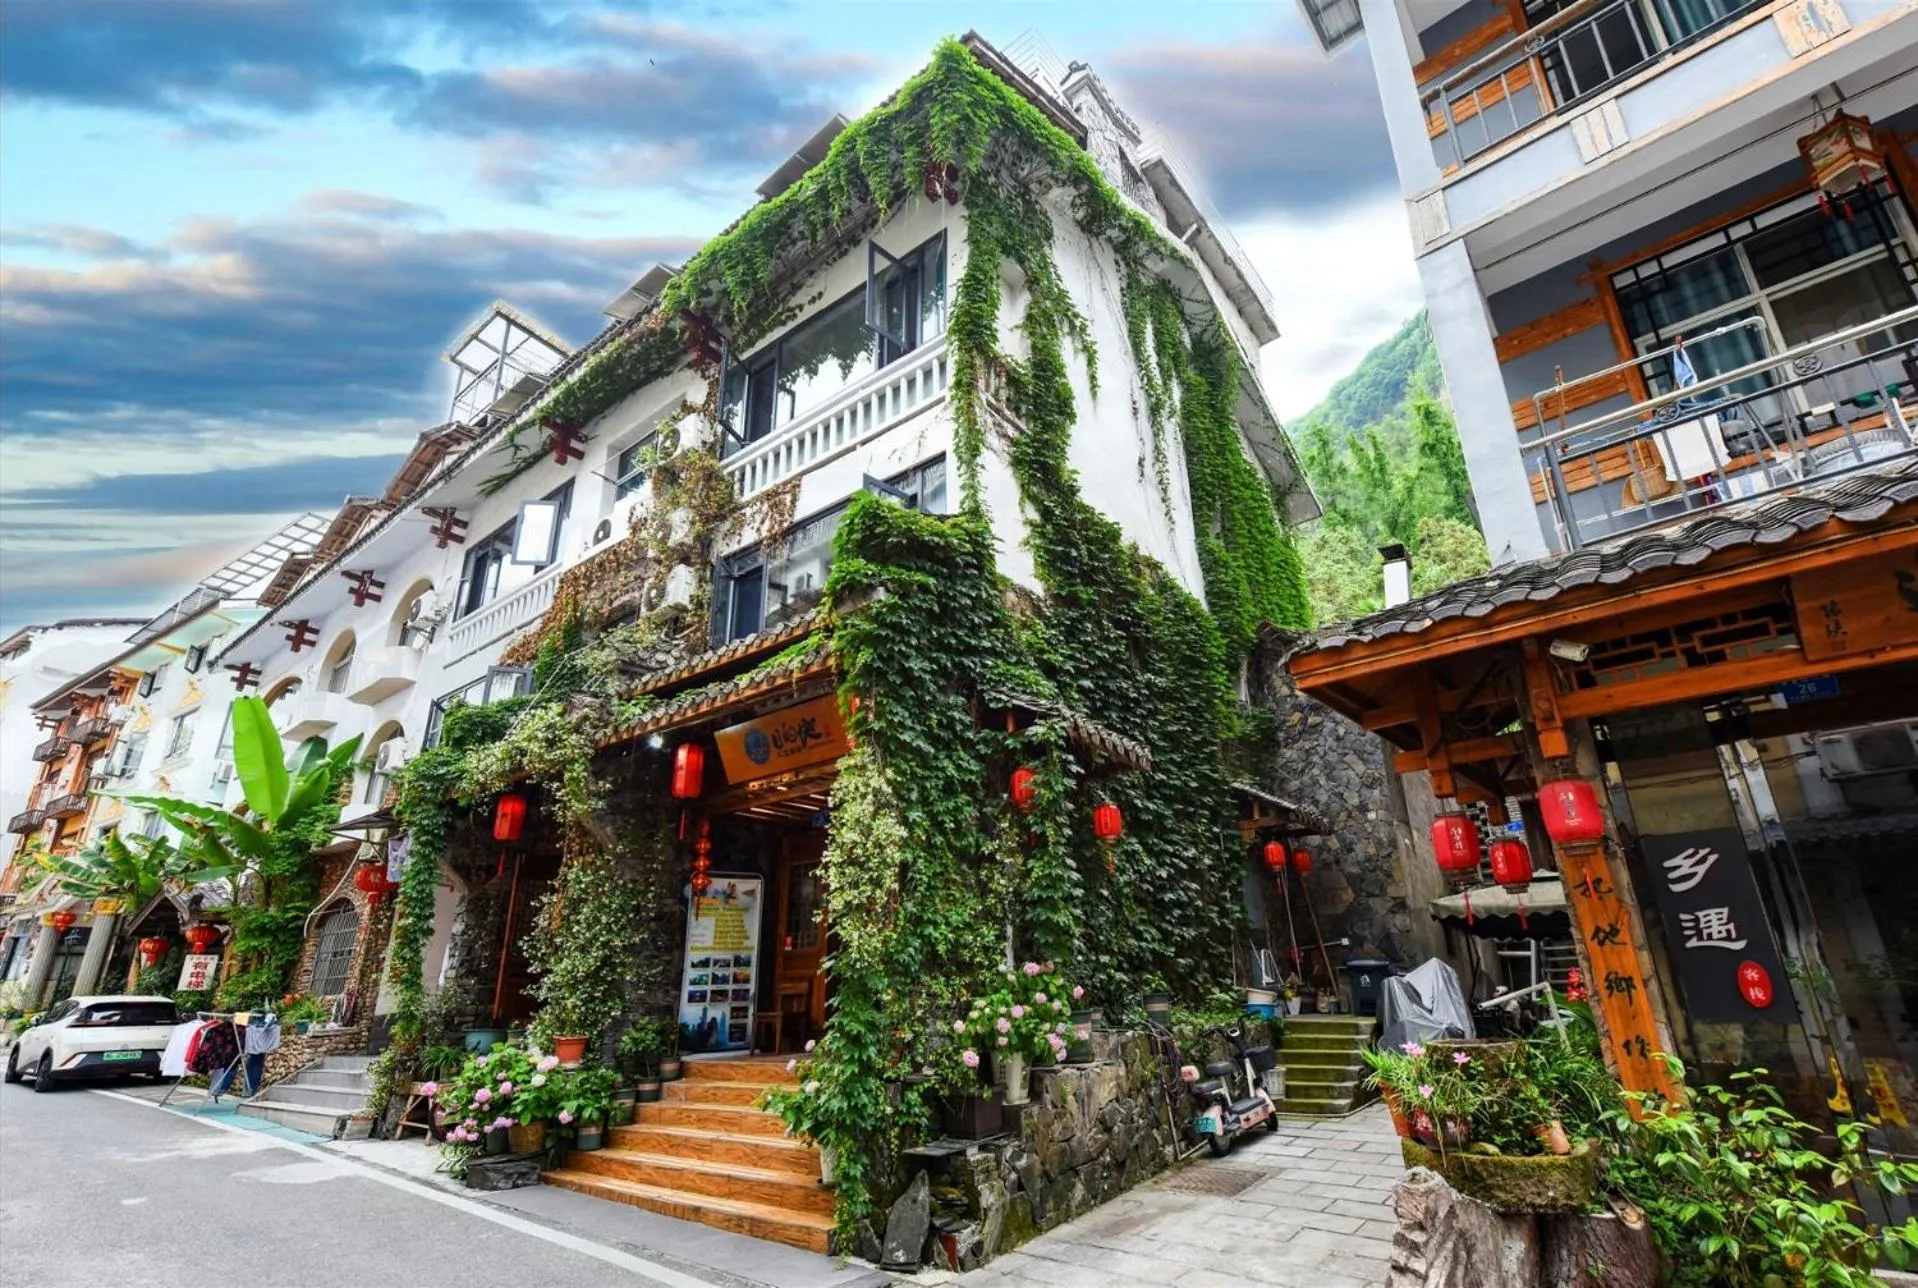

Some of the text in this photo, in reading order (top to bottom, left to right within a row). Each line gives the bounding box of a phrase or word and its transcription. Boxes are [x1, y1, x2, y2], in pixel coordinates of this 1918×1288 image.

[1799, 682, 1818, 696] 26
[1662, 847, 1748, 950] 乡遇
[187, 962, 209, 988] 有电梯
[1744, 968, 1766, 1001] 客栈
